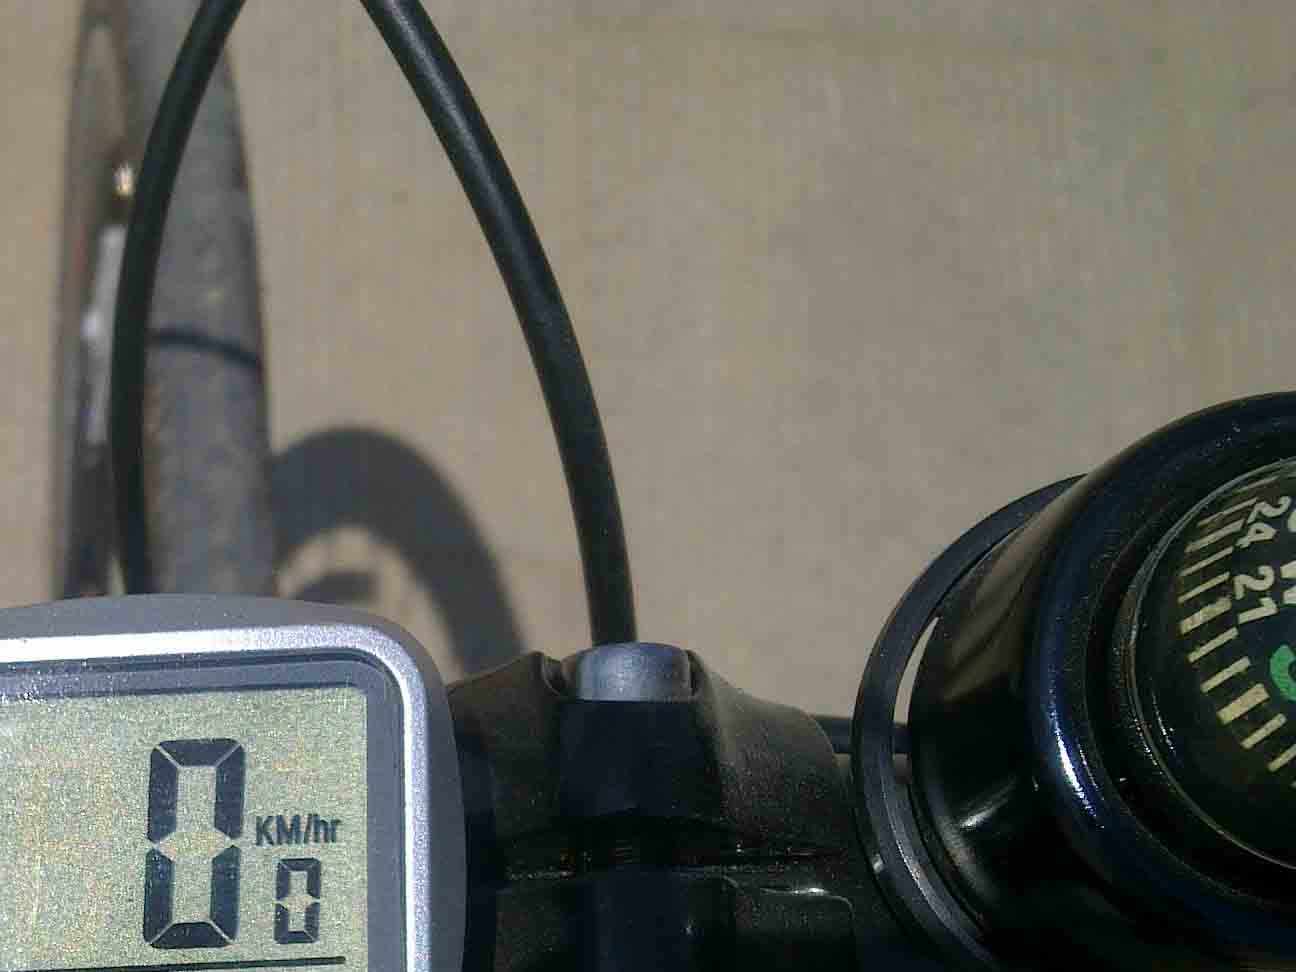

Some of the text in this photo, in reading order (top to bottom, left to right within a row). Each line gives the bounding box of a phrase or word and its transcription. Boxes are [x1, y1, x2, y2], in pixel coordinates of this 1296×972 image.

[142, 738, 246, 949] 0
[255, 815, 344, 847] KM/hr
[273, 857, 322, 944] 0
